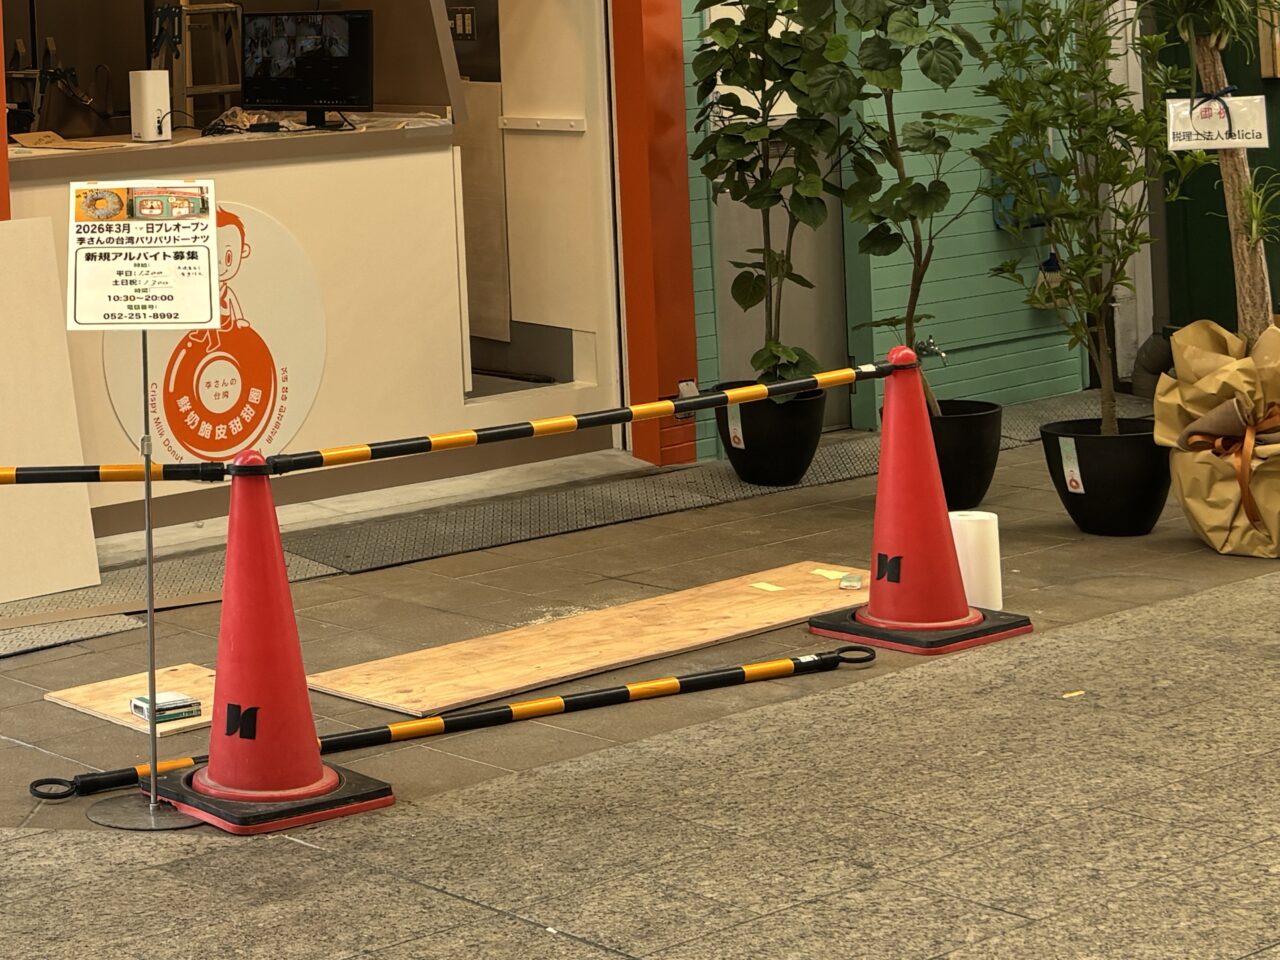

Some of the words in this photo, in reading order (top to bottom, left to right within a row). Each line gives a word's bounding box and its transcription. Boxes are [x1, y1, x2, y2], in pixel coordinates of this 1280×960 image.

[75, 223, 131, 235] 2026年3月
[84, 250, 199, 262] 新規アルバイト募集
[103, 312, 180, 320] 052-251-8992
